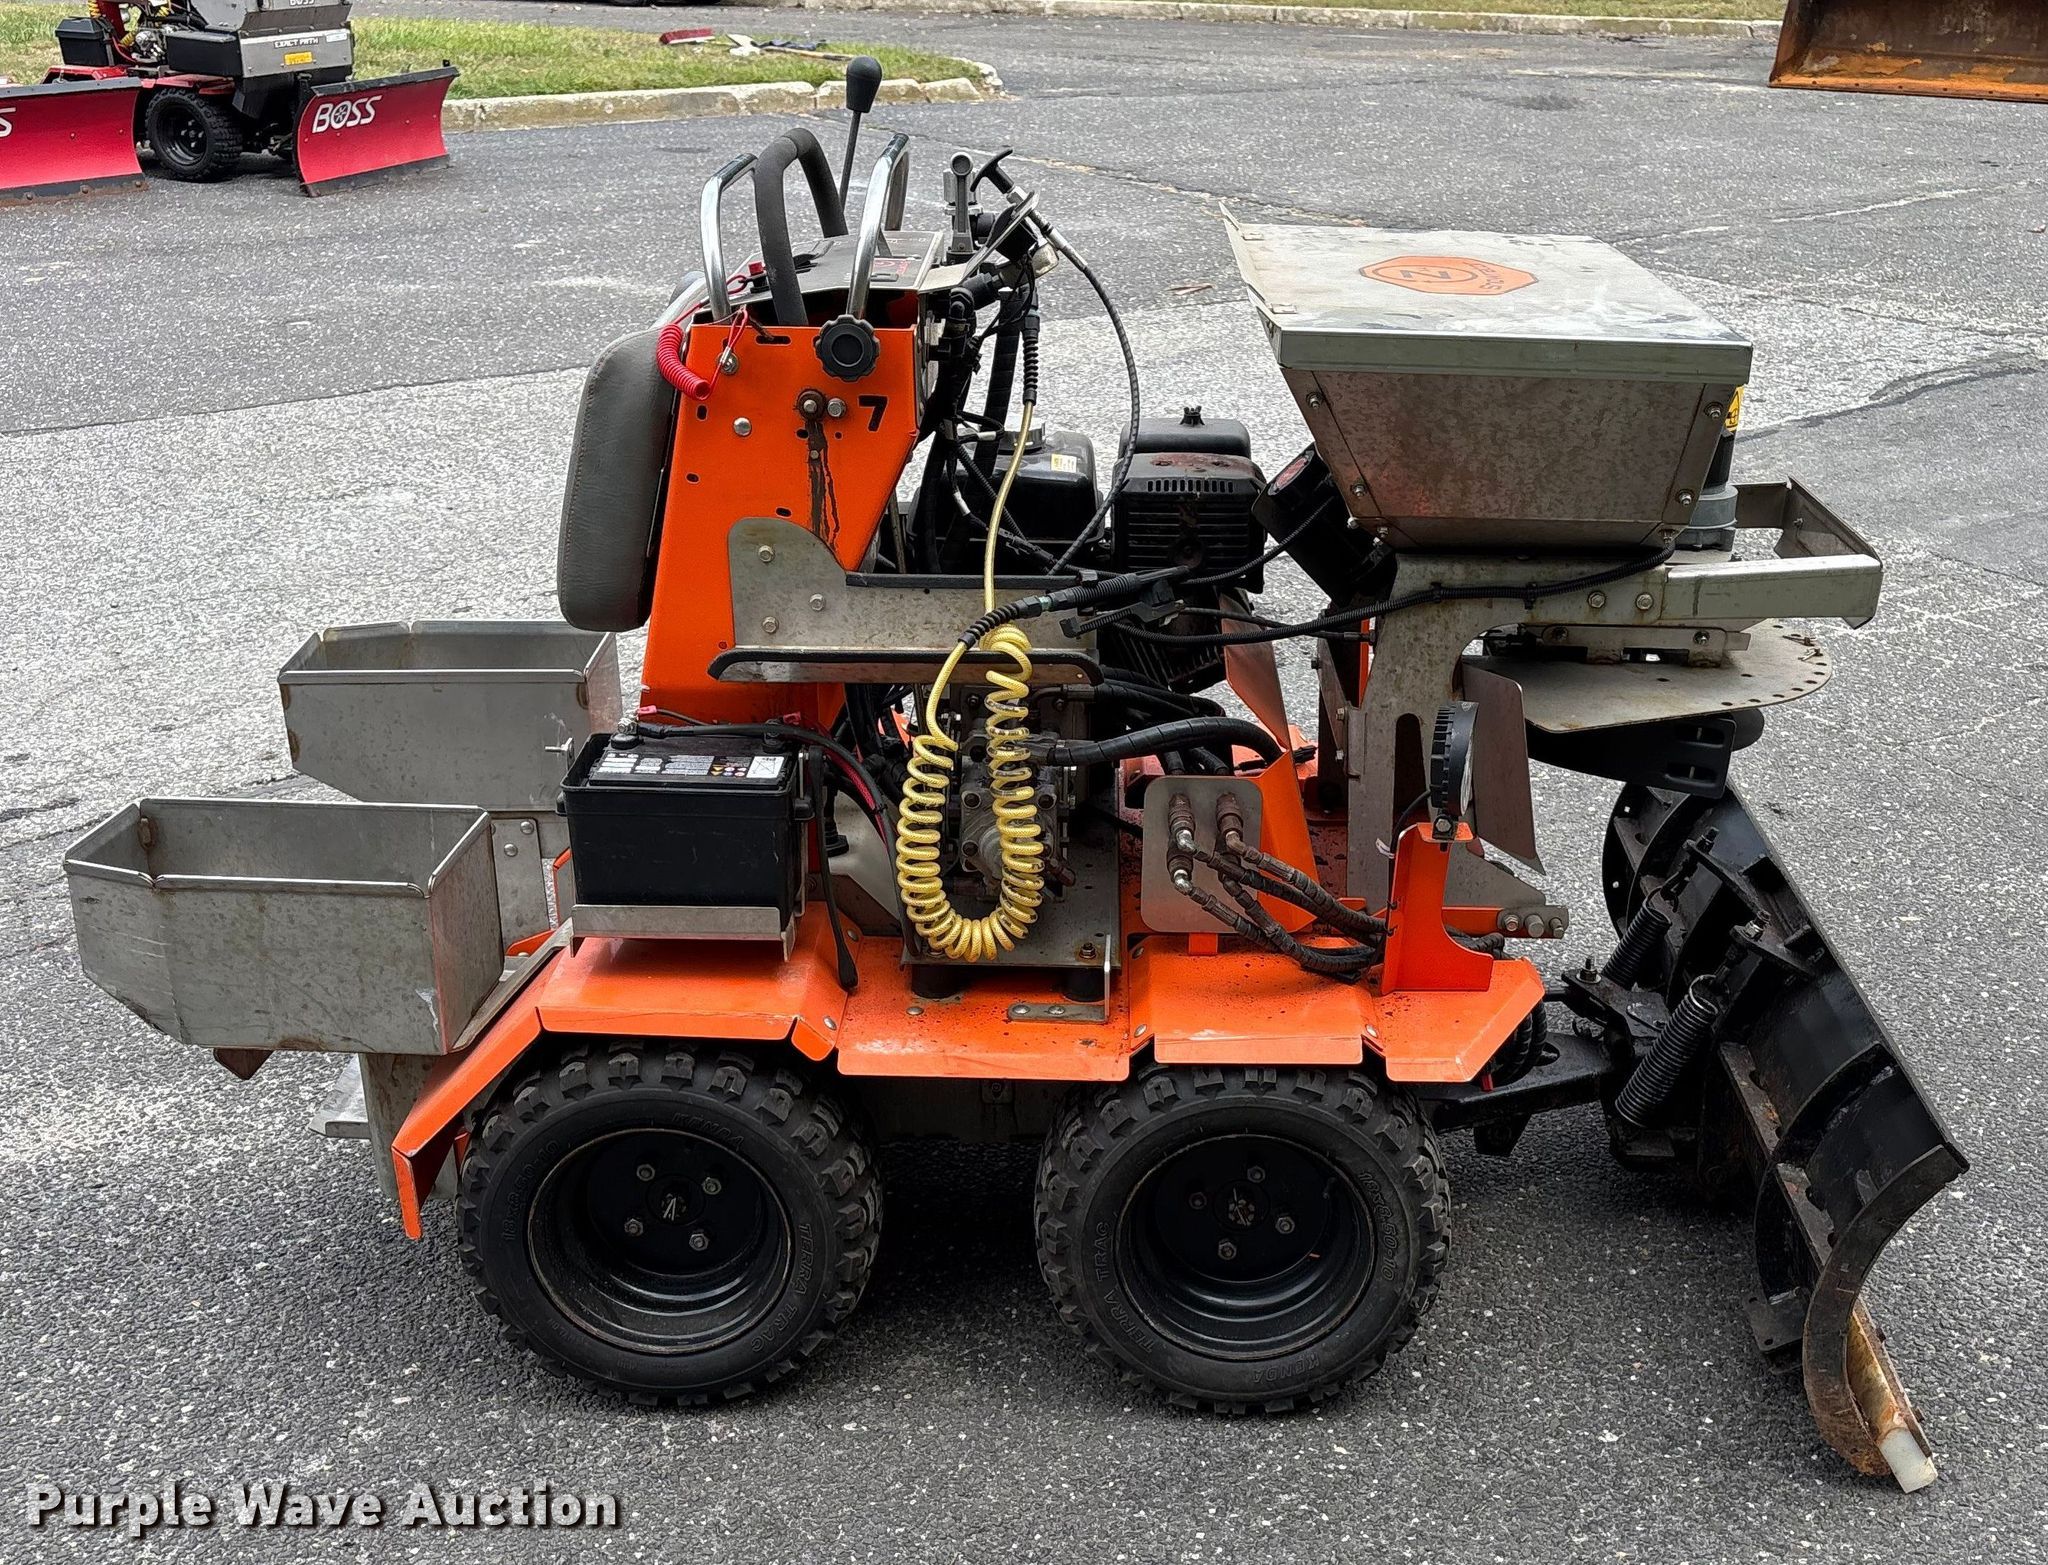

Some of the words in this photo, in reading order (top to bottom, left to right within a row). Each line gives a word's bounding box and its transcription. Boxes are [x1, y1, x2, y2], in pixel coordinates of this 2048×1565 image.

[312, 95, 383, 134] BOSS
[858, 394, 889, 433] 7
[795, 1222, 815, 1295] TERRA
[1093, 1220, 1111, 1283] TRAC
[751, 1303, 798, 1354] TRAC
[1102, 1289, 1156, 1355] TERRA
[1252, 1351, 1321, 1385] KENDA
